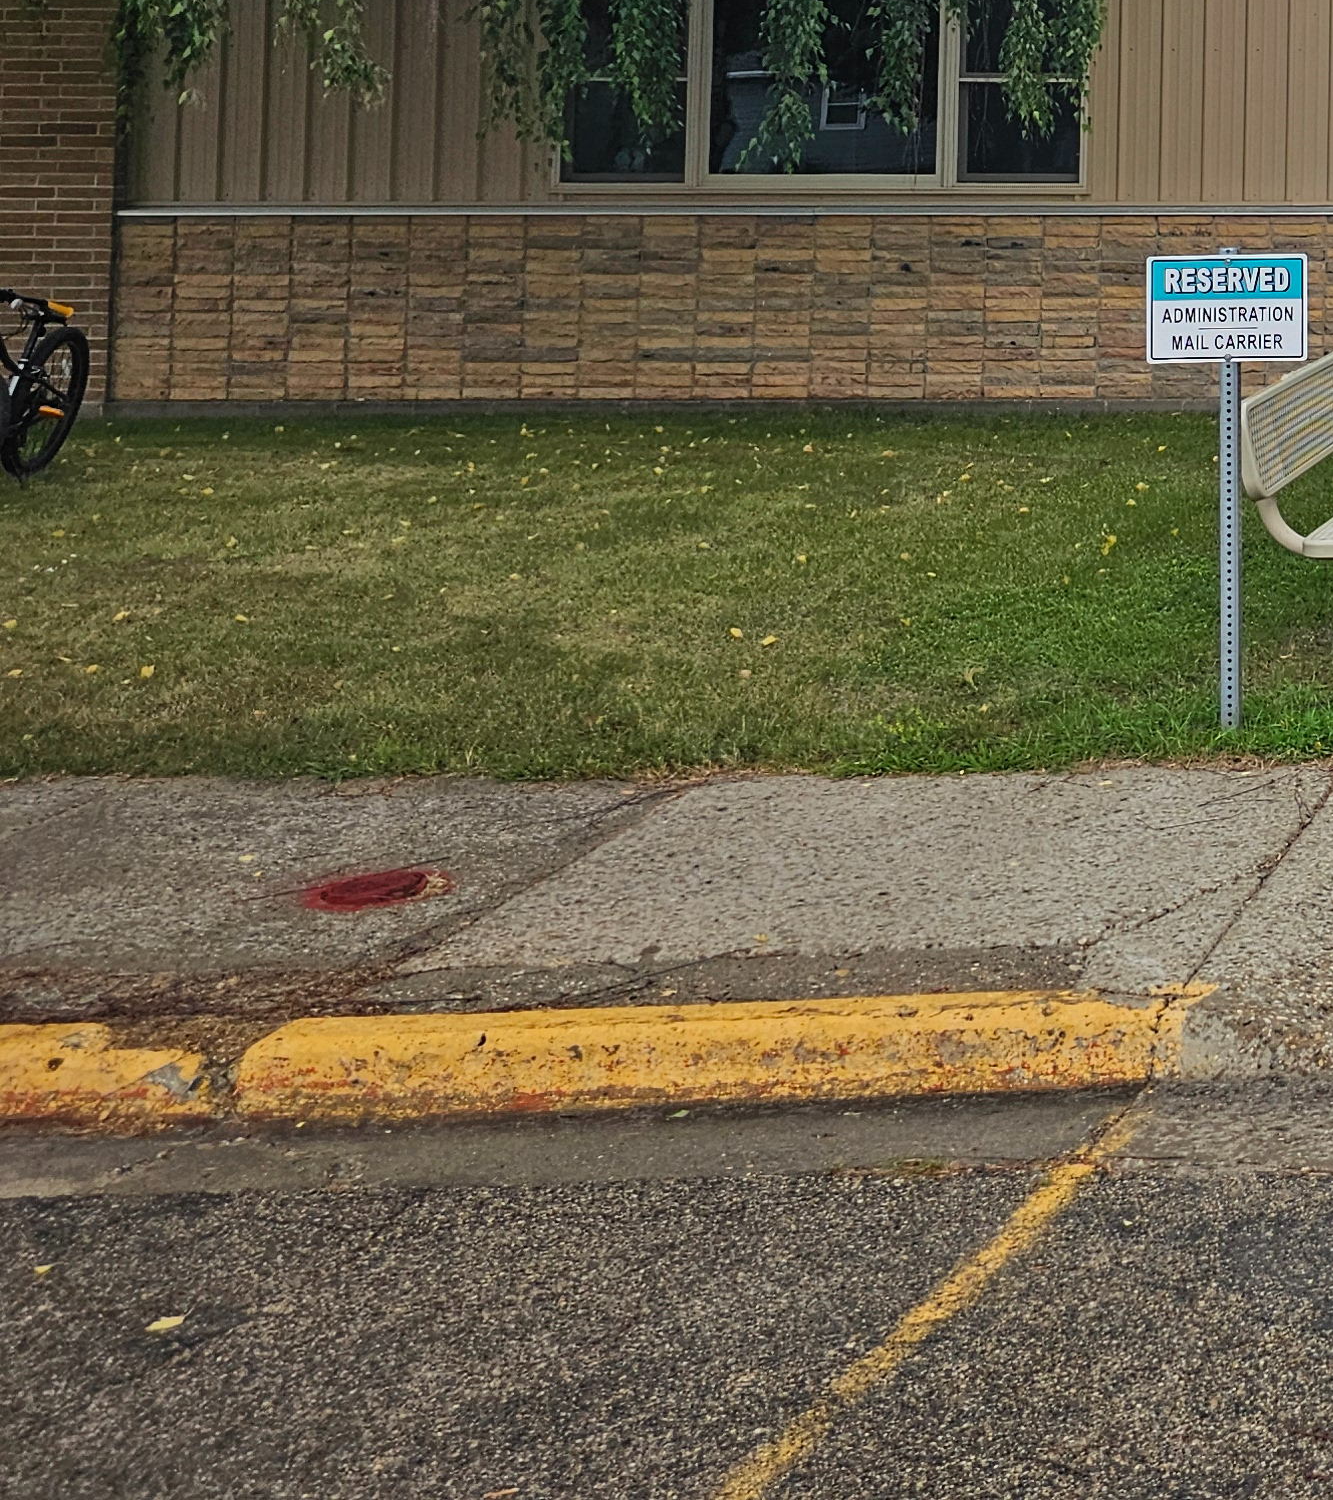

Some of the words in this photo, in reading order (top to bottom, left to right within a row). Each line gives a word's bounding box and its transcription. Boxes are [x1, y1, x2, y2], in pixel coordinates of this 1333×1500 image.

[1164, 266, 1291, 294] RESERVED
[1162, 306, 1294, 324] ADMINISTRATION
[1172, 334, 1210, 351] MAIL
[1214, 333, 1283, 350] CARRIER
